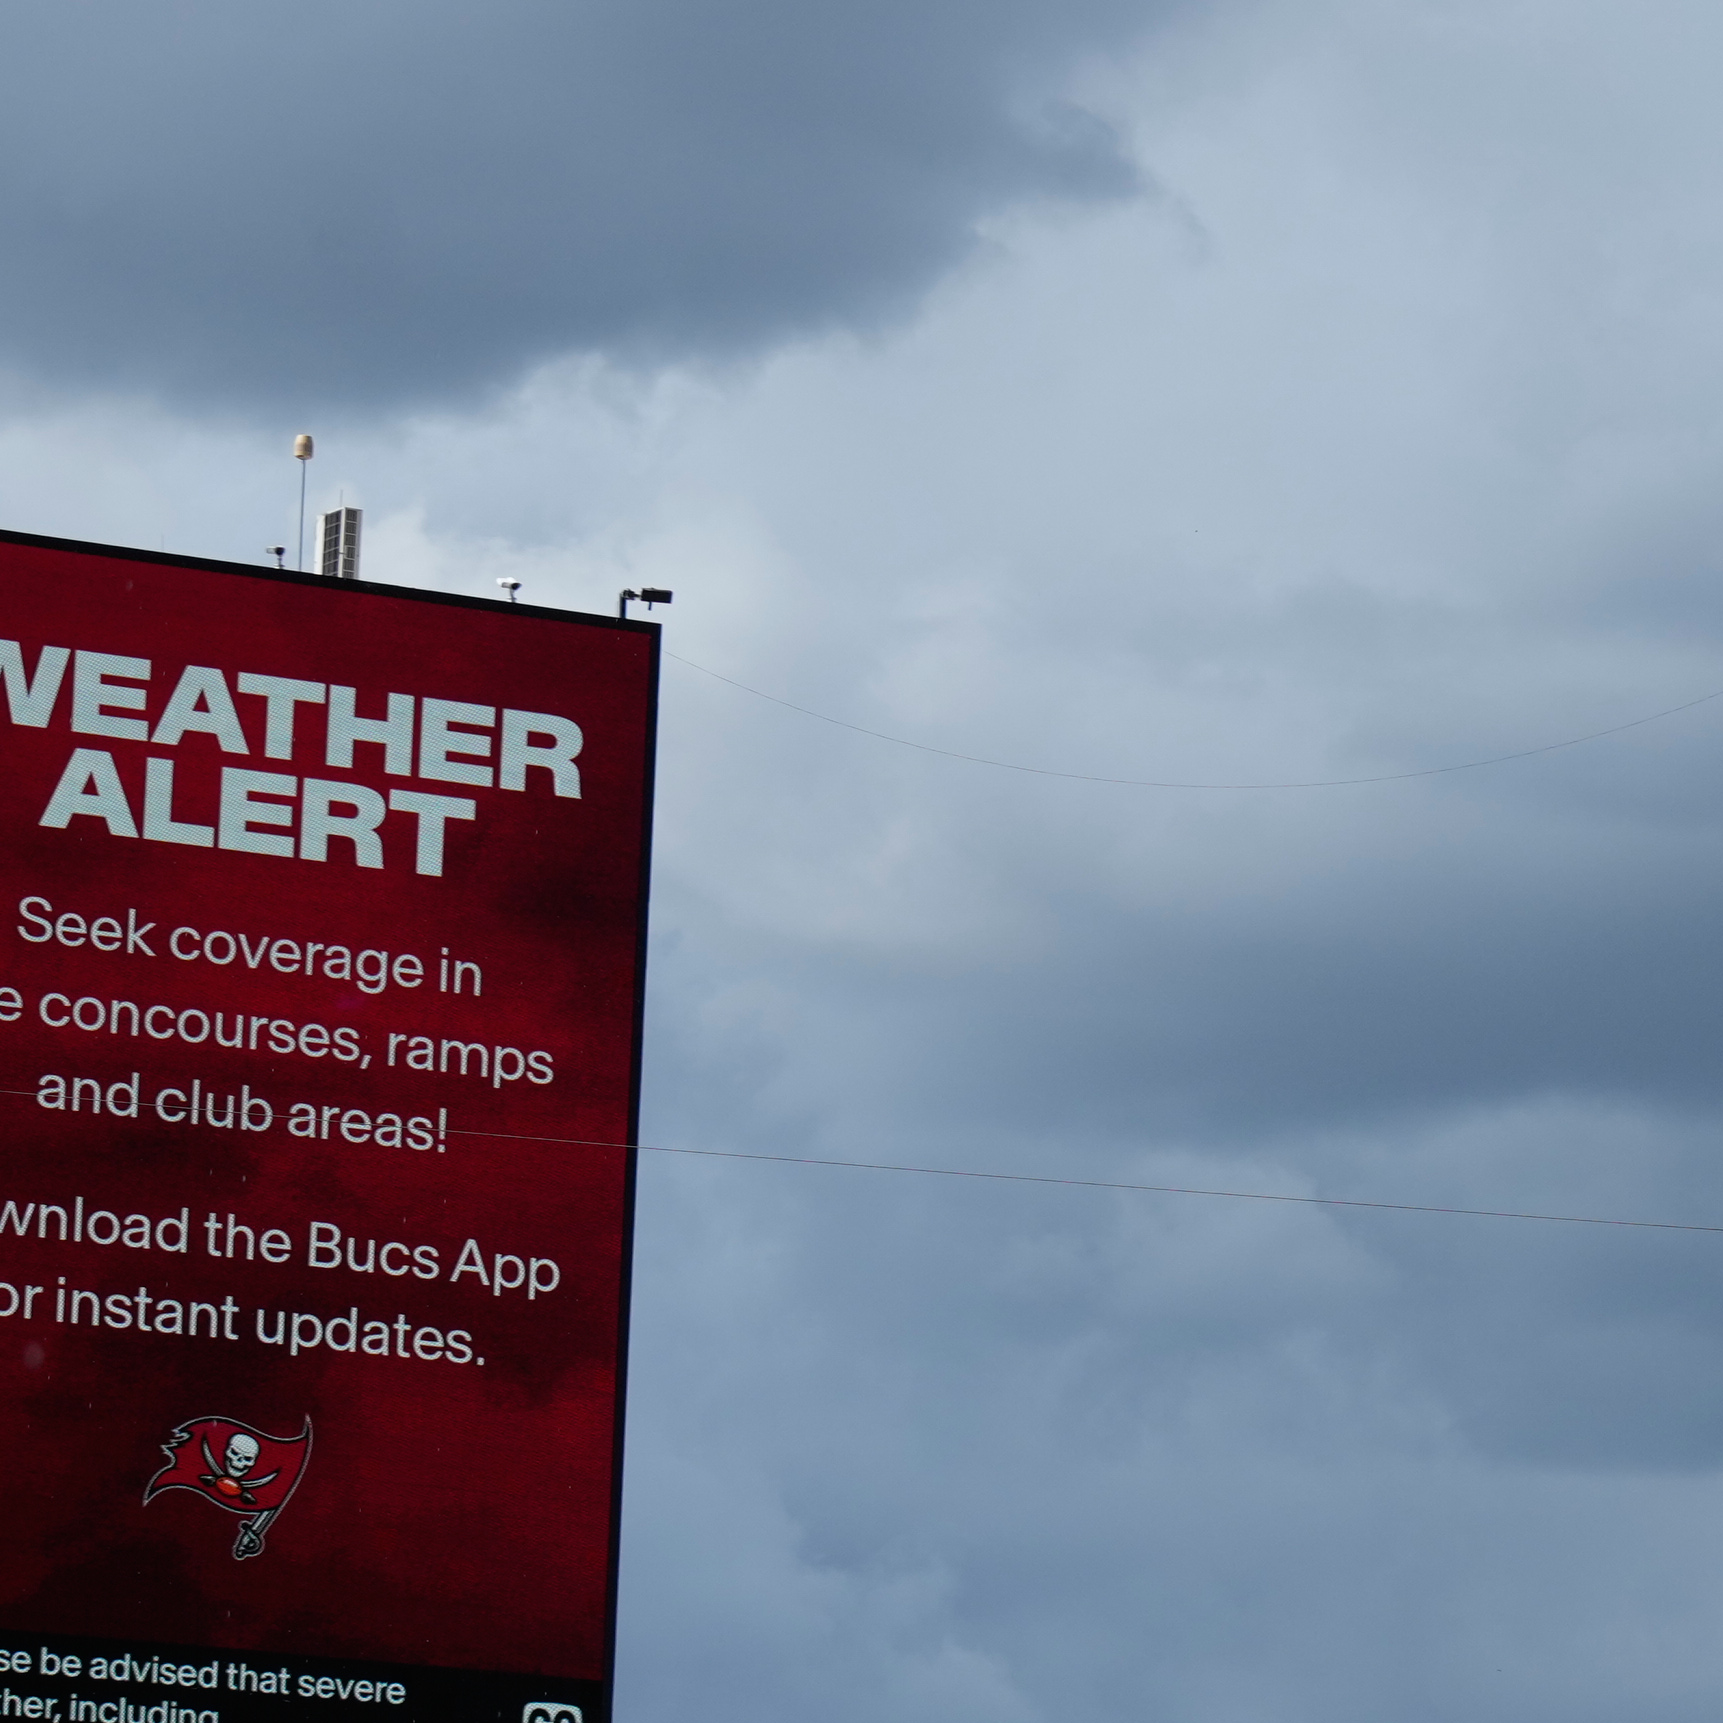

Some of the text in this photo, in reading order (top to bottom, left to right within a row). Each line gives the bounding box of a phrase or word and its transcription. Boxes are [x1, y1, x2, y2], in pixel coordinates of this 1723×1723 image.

[39, 748, 477, 878] ALERT
[17, 896, 482, 998] Seek coverage in
[38, 991, 373, 1071] concourses,
[387, 1031, 555, 1089] ramps
[36, 1072, 449, 1154] and club areas!
[205, 1211, 292, 1264] the
[308, 1221, 440, 1280] Bucs
[449, 1239, 560, 1300] App
[56, 1277, 240, 1342] instant
[256, 1306, 486, 1366] updates.
[41, 1646, 82, 1679] be
[89, 1653, 219, 1689] advised
[227, 1661, 291, 1696] that
[298, 1671, 406, 1704] severe
